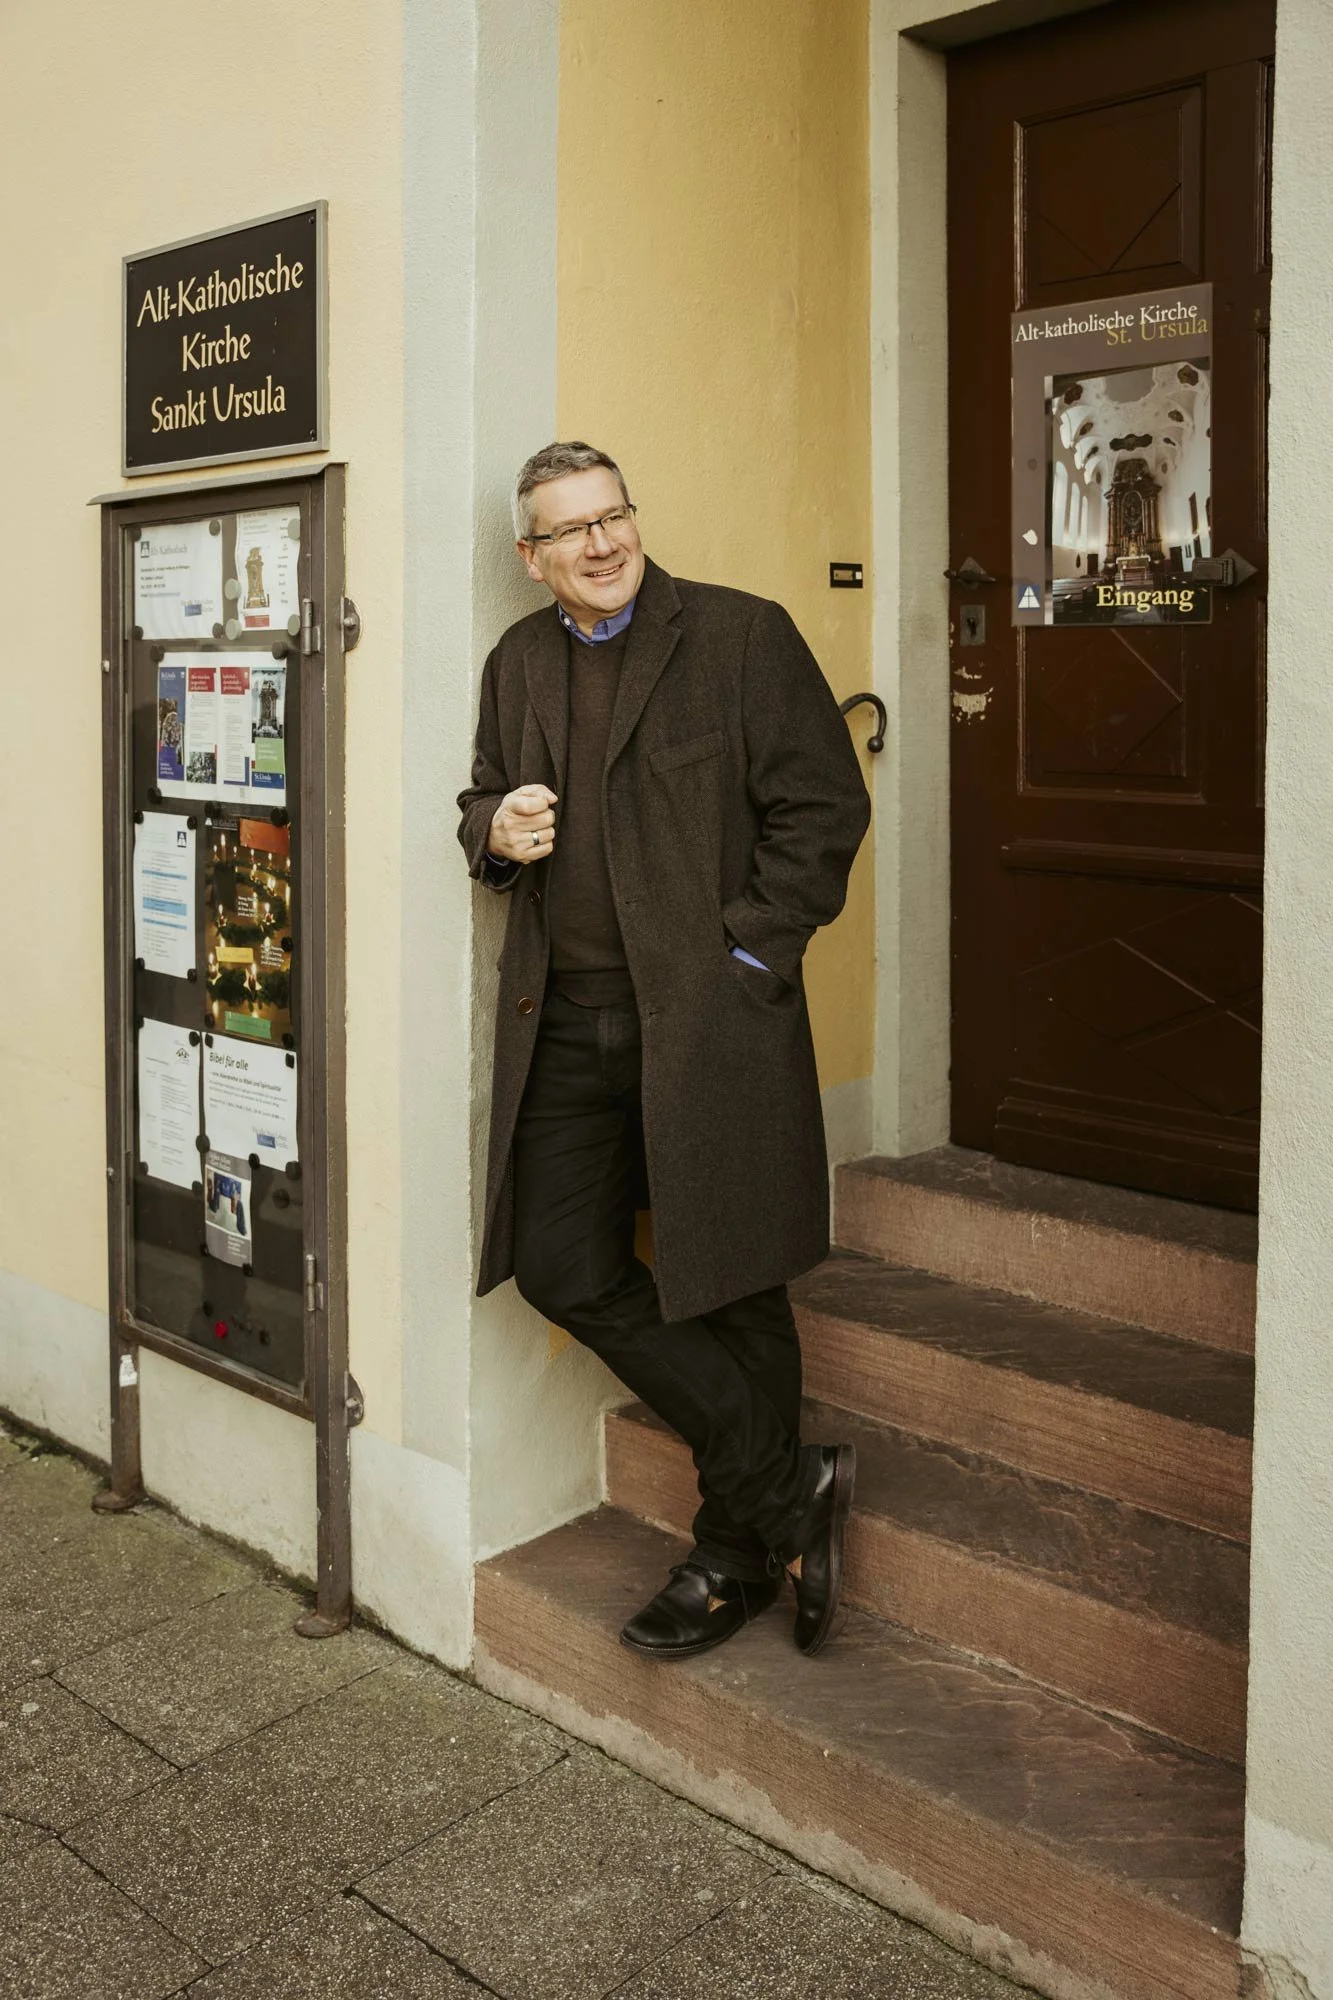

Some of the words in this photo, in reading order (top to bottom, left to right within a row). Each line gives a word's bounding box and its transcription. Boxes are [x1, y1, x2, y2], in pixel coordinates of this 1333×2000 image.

[136, 252, 304, 328] Alt-Katholische
[1014, 310, 1135, 343] Alt-katholische
[1139, 301, 1198, 325] Kirche
[1106, 325, 1132, 347] St.
[1140, 316, 1208, 341] Ursula
[181, 324, 252, 373] Kirche
[151, 389, 207, 434] Sankt
[212, 374, 287, 423] Ursula
[1096, 584, 1195, 614] Eingang
[209, 1052, 225, 1064] Bibel
[225, 1055, 235, 1068] für
[236, 1058, 249, 1071] alle
